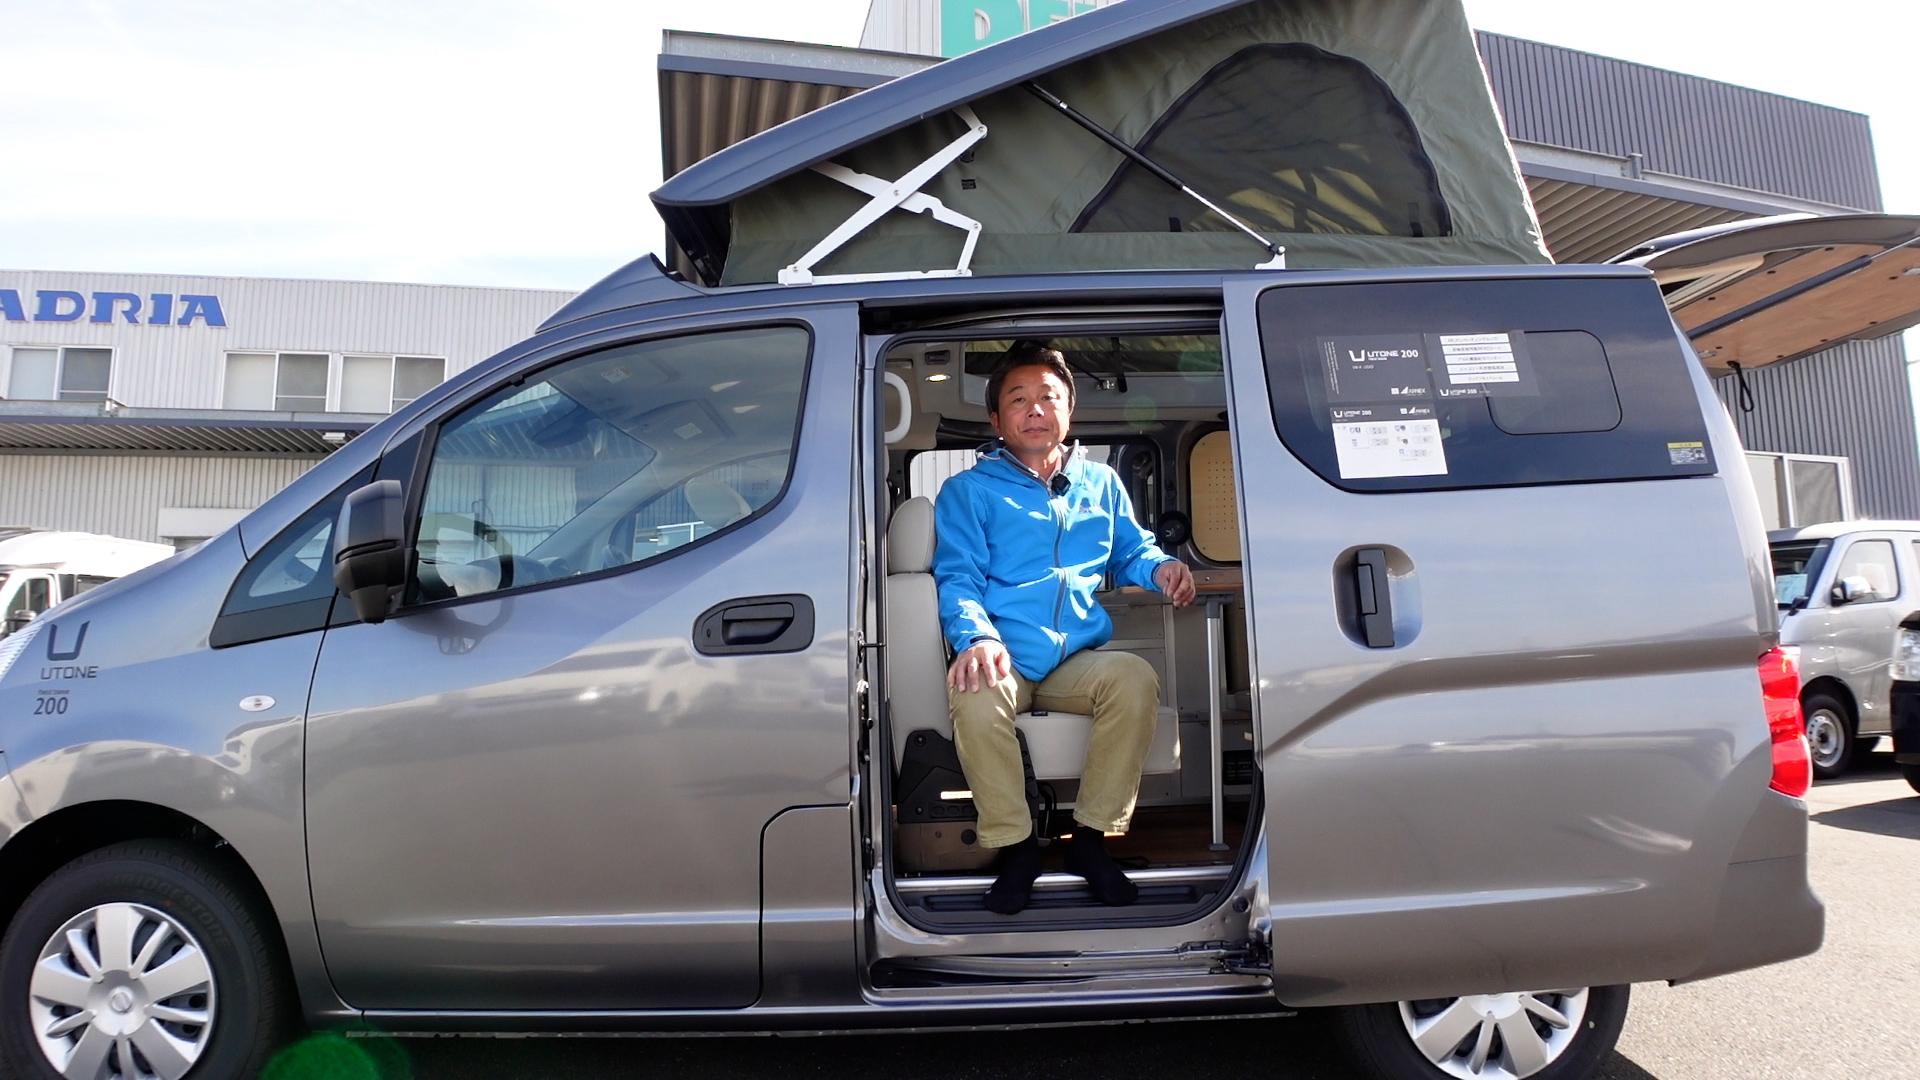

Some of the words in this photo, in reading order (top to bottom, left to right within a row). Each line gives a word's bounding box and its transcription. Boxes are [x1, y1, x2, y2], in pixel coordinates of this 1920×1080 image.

[1367, 350, 1399, 358] UTONE
[1400, 349, 1419, 358] 200
[41, 665, 99, 680] UTONE
[33, 696, 69, 715] 200
